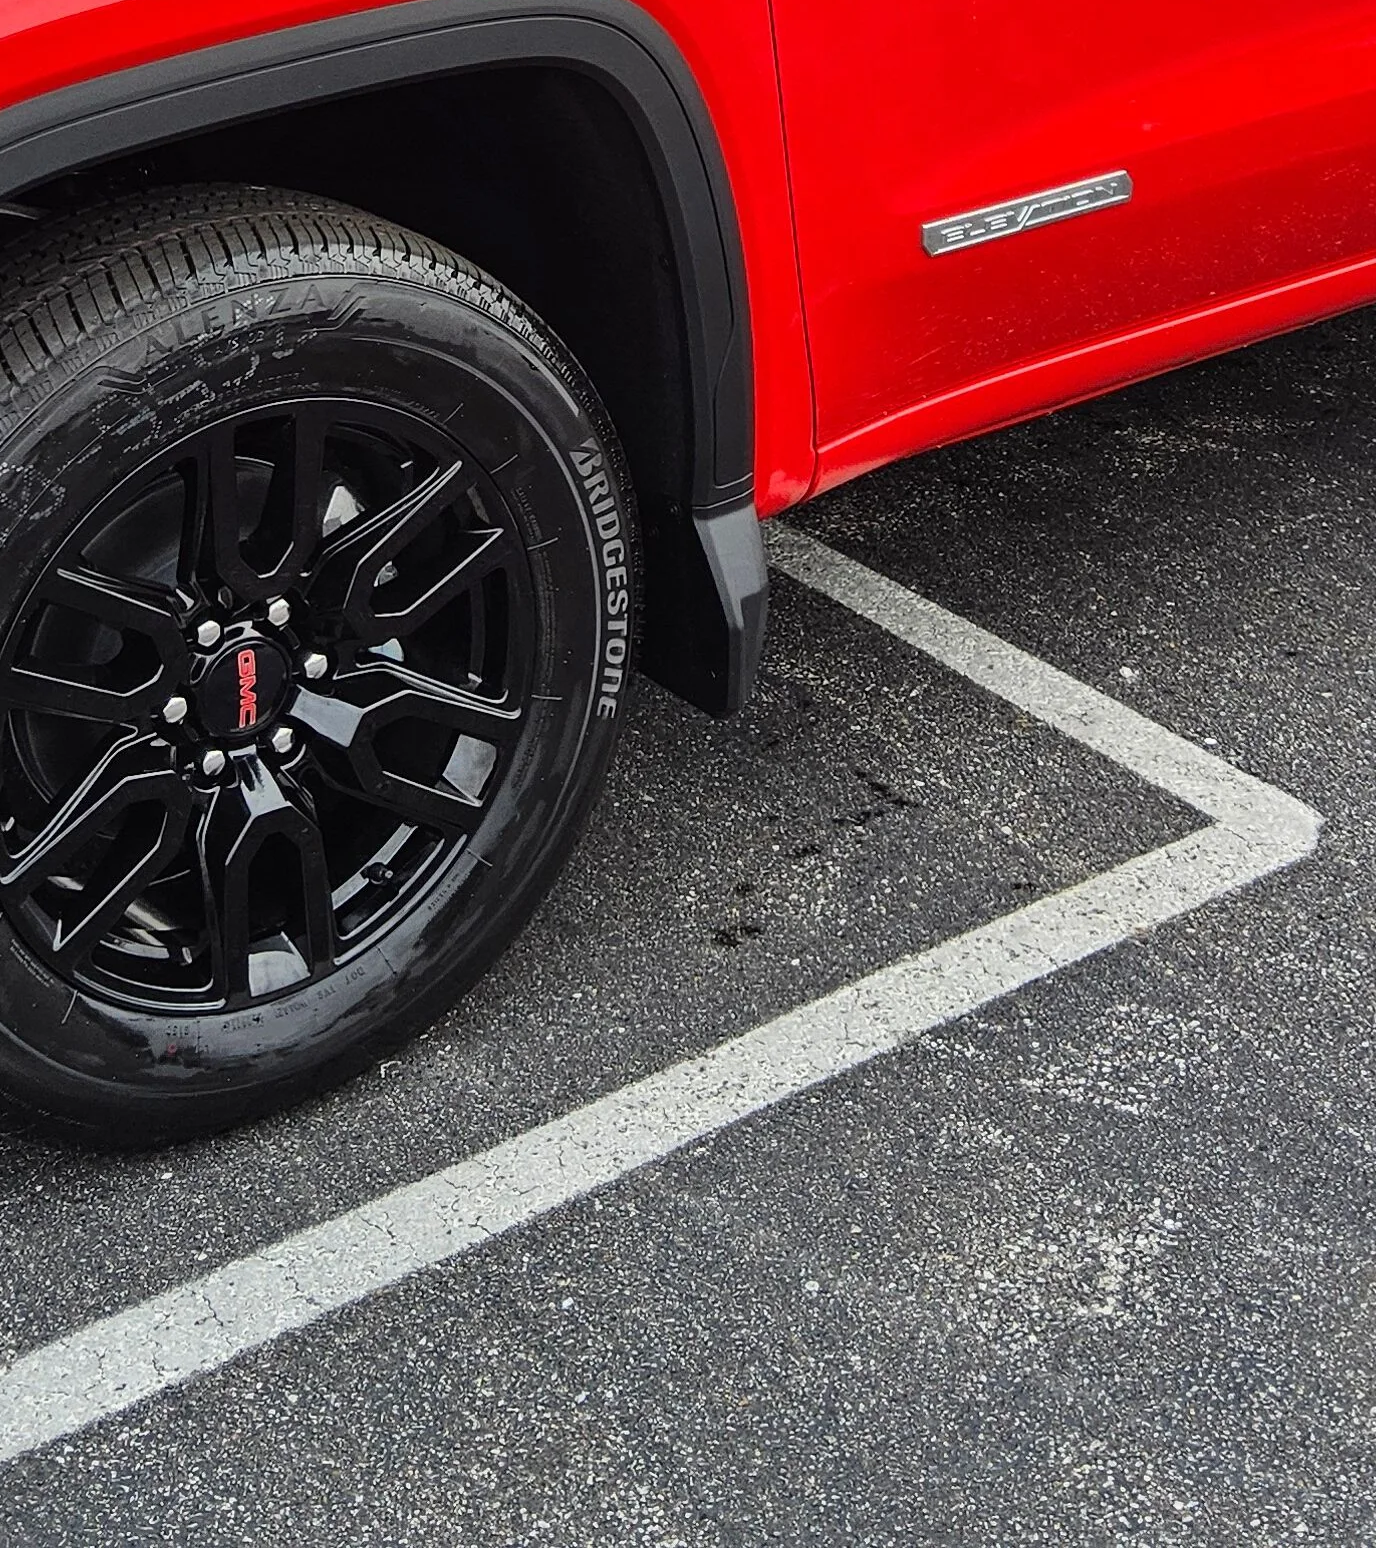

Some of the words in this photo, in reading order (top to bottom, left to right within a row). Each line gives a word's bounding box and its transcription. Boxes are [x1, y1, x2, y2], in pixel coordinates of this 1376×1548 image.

[145, 283, 328, 365] ALENZA
[570, 437, 629, 719] BRIDGESTONE
[237, 649, 256, 728] GMC
